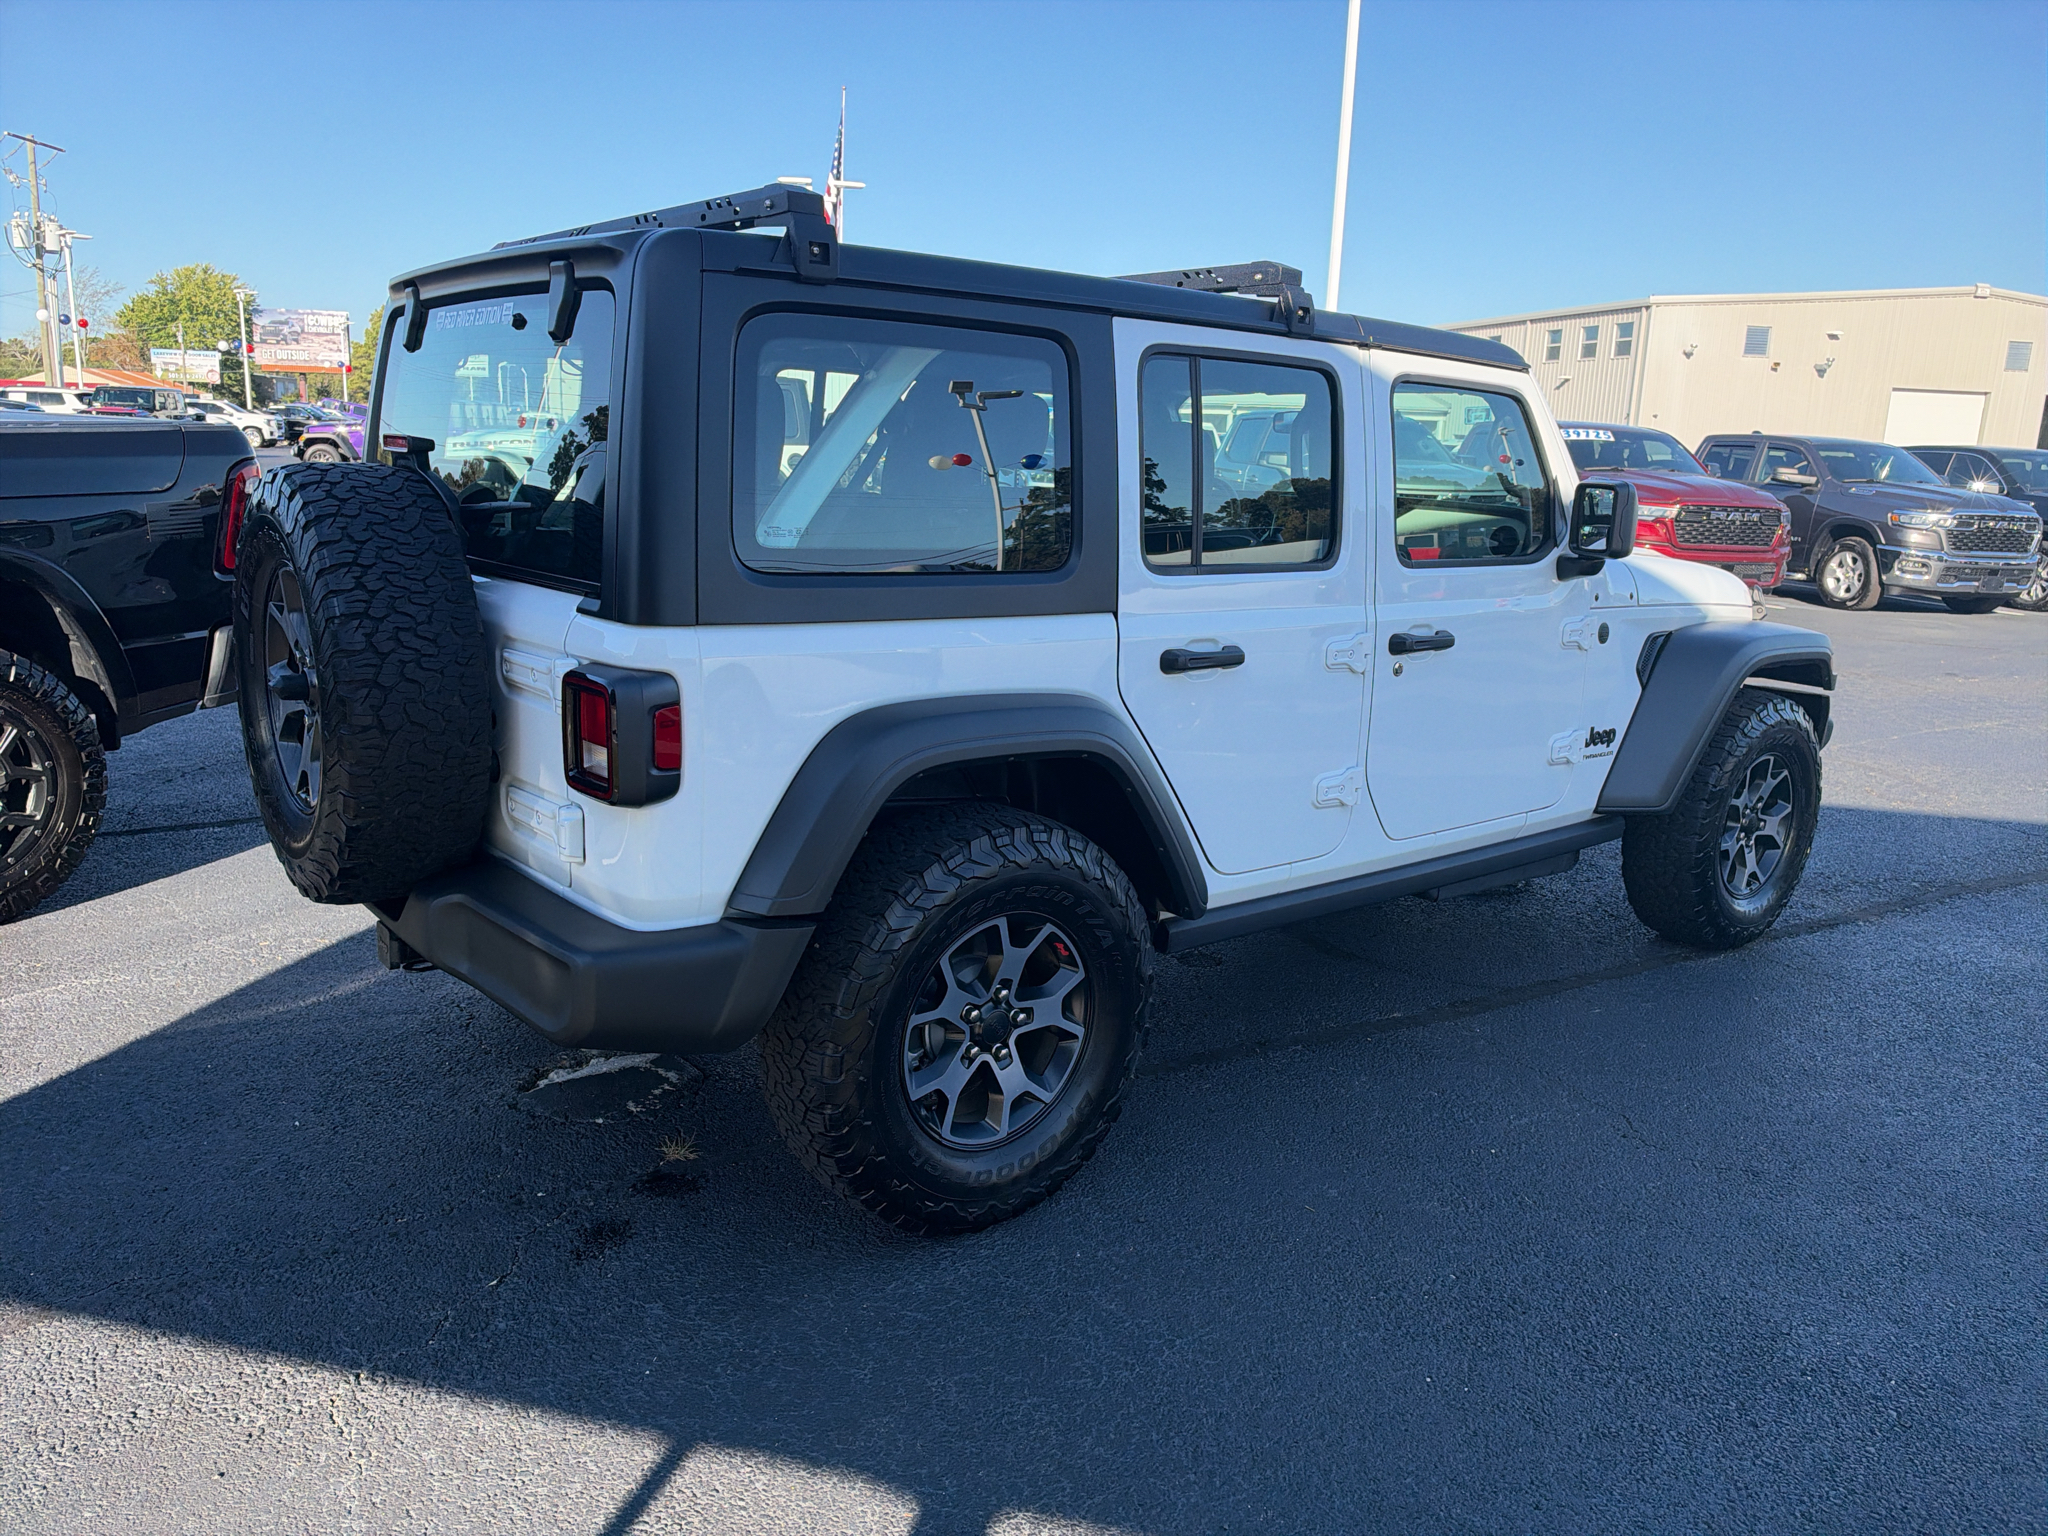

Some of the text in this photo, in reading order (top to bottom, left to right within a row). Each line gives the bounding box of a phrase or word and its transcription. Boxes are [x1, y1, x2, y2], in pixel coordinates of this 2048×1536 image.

[444, 312, 458, 329] RED
[456, 309, 475, 327] RIVER
[474, 305, 503, 325] EDITION
[262, 349, 310, 360] GET OUTSIDE
[1562, 429, 1612, 440] 39725
[452, 439, 536, 448] RUBICON
[1710, 511, 1760, 521] RAM
[1981, 520, 2025, 530] RAM
[1584, 726, 1617, 748] Jeep
